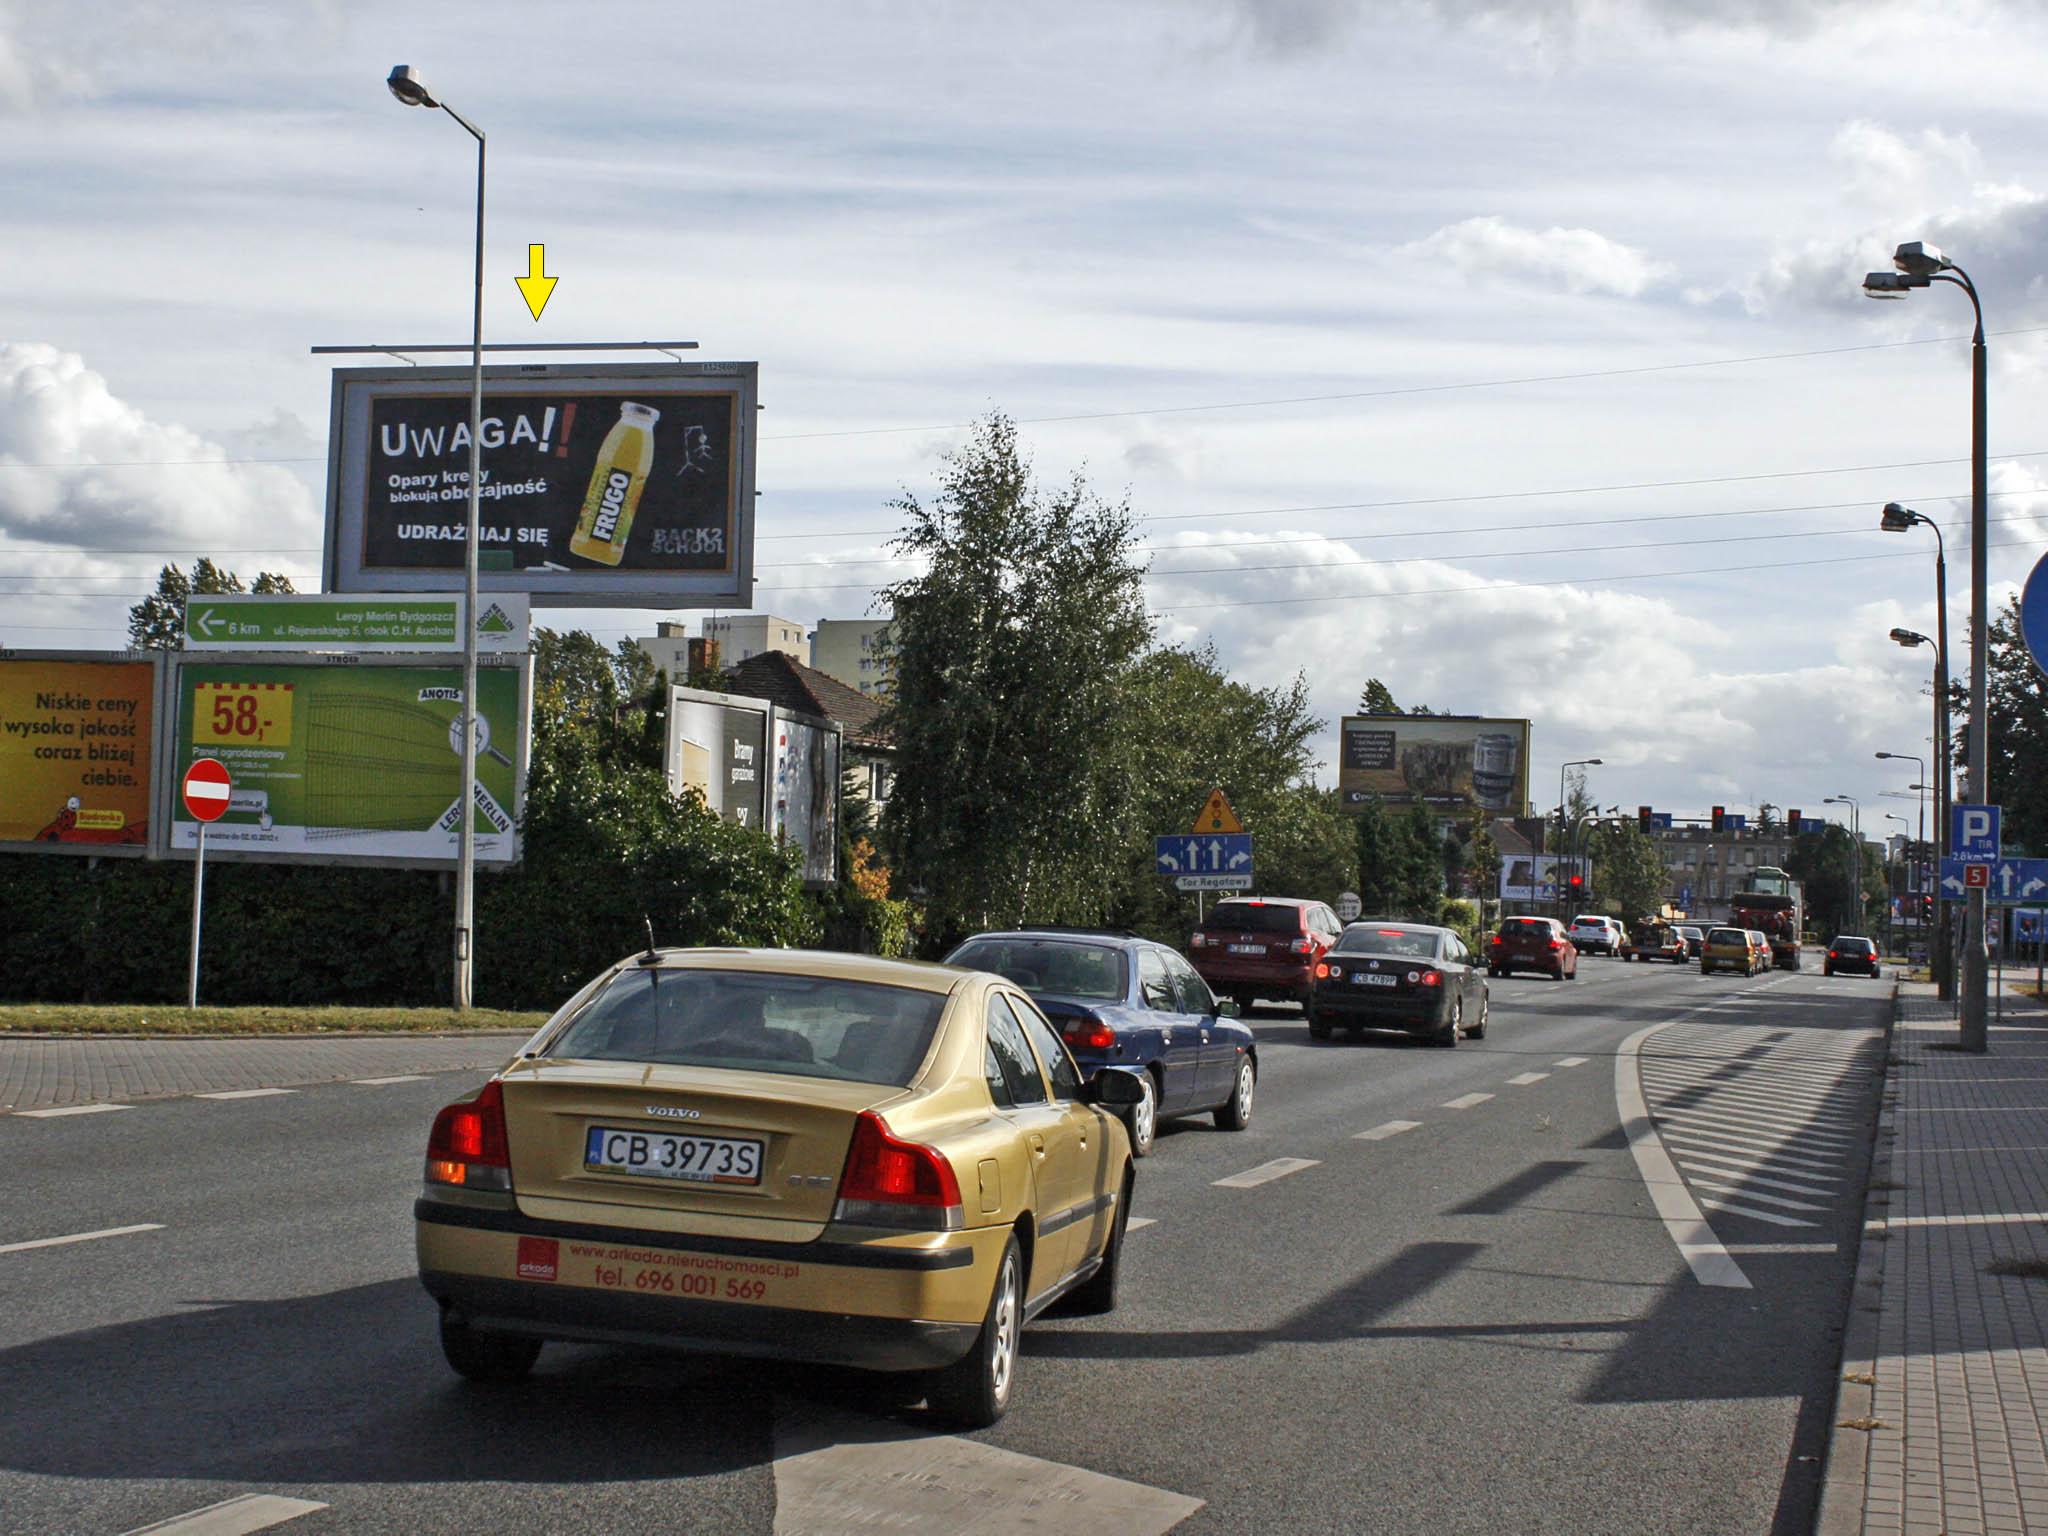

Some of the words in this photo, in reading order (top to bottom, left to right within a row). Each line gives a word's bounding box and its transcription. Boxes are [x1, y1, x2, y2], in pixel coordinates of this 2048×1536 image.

[388, 474, 438, 490] Opary
[442, 470, 490, 485] krey
[390, 490, 439, 503] blokują
[592, 472, 629, 541] FRUGO
[398, 522, 511, 542] UDRAŻIAJ
[516, 528, 549, 547] SIĘ
[653, 527, 723, 543] BACK2
[652, 539, 725, 554] SCHOOL
[336, 612, 363, 623] Leroy
[366, 611, 396, 622] Merlin
[400, 611, 455, 623] Bydgoszcz
[491, 602, 515, 631] MERLIN
[229, 622, 236, 634] 6
[240, 623, 260, 634] km
[273, 626, 285, 635] ul.
[364, 626, 388, 636] obok
[391, 626, 412, 636] C.H.
[415, 626, 455, 636] Auchan
[36, 692, 92, 711] Niskie
[96, 699, 138, 717] ceny
[212, 694, 273, 742] 58,-
[5, 716, 74, 738] wysoka
[80, 718, 136, 740] jakość
[34, 746, 82, 760] coraz
[88, 743, 135, 767] bliżej
[81, 768, 138, 786] ciebie.
[440, 801, 462, 831] LER
[473, 784, 510, 833] MERLIN
[1962, 810, 1990, 846] P
[1978, 840, 1993, 849] TIR
[1183, 878, 1197, 887] Tor
[1971, 869, 1980, 882] 5
[1356, 973, 1370, 983] CB
[644, 1106, 701, 1119] VOLVO
[607, 1134, 650, 1166] CB
[661, 1138, 755, 1175] 3973S
[519, 1264, 554, 1274] arkada
[569, 1244, 800, 1279] www.arkada.nieruchomosci.pl
[595, 1265, 627, 1287] tel.
[635, 1270, 674, 1292] 696
[681, 1273, 717, 1296] 001
[726, 1278, 766, 1299] 569
